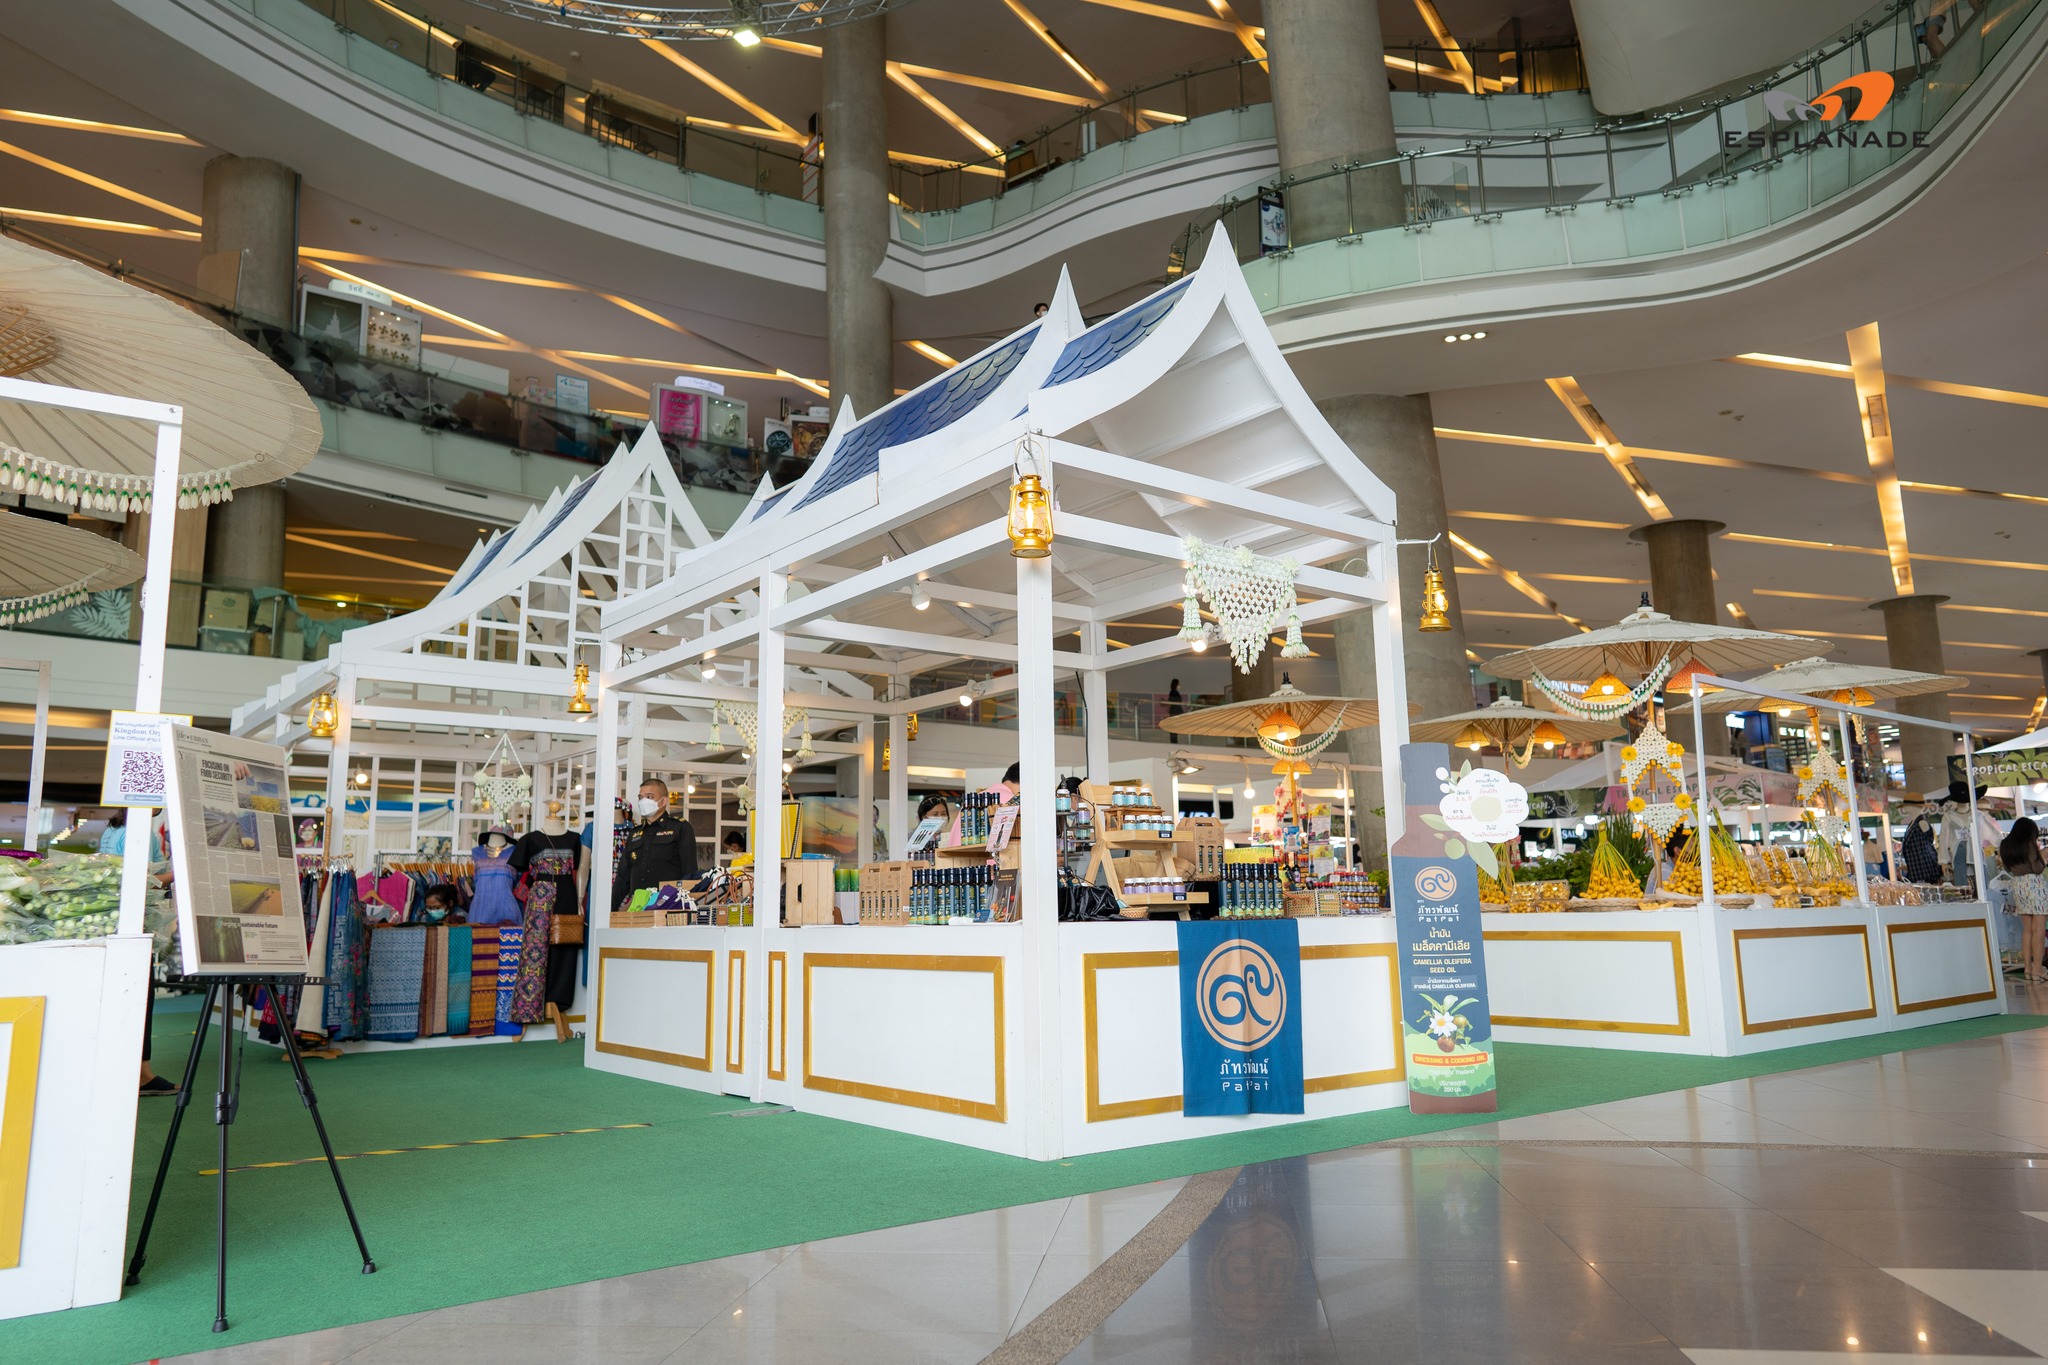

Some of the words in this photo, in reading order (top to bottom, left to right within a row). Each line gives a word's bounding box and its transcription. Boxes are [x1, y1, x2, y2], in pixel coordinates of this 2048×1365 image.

[114, 727, 147, 735] Kingdom
[202, 760, 223, 771] FOCUSING
[223, 763, 230, 772] ON
[200, 768, 212, 777] FOOD
[212, 770, 233, 782] SECURITY
[1562, 829, 1588, 840] SALD
[1418, 904, 1459, 914] ภัทรพัฒน์
[1429, 927, 1451, 938] น้ำมัน
[1412, 939, 1470, 951] เมล็ดคามีเลีย
